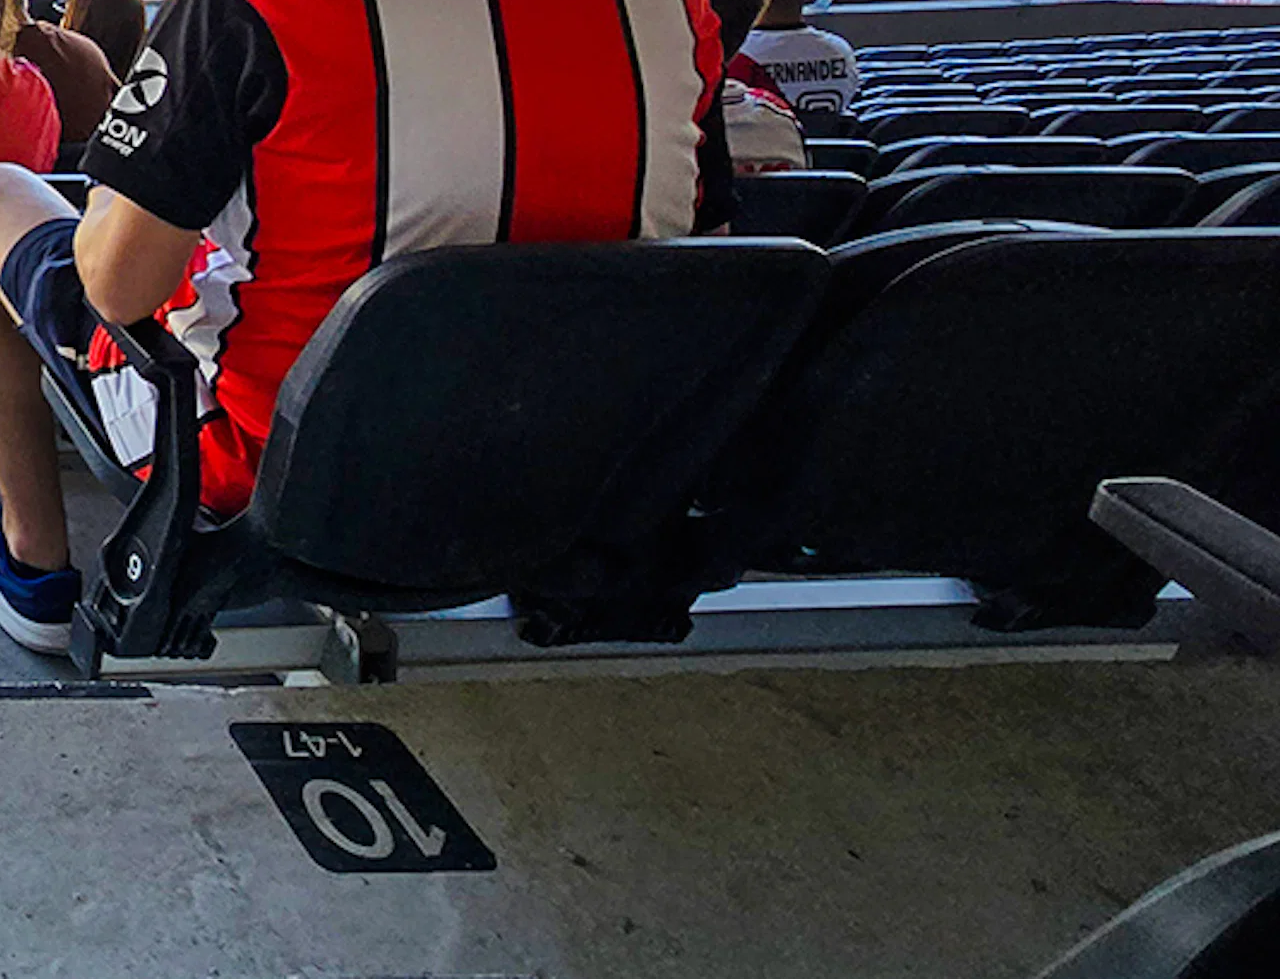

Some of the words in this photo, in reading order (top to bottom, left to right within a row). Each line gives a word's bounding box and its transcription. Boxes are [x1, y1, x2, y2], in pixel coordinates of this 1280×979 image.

[126, 553, 142, 581] 9
[282, 730, 363, 758] 1-47
[302, 778, 447, 859] 10
